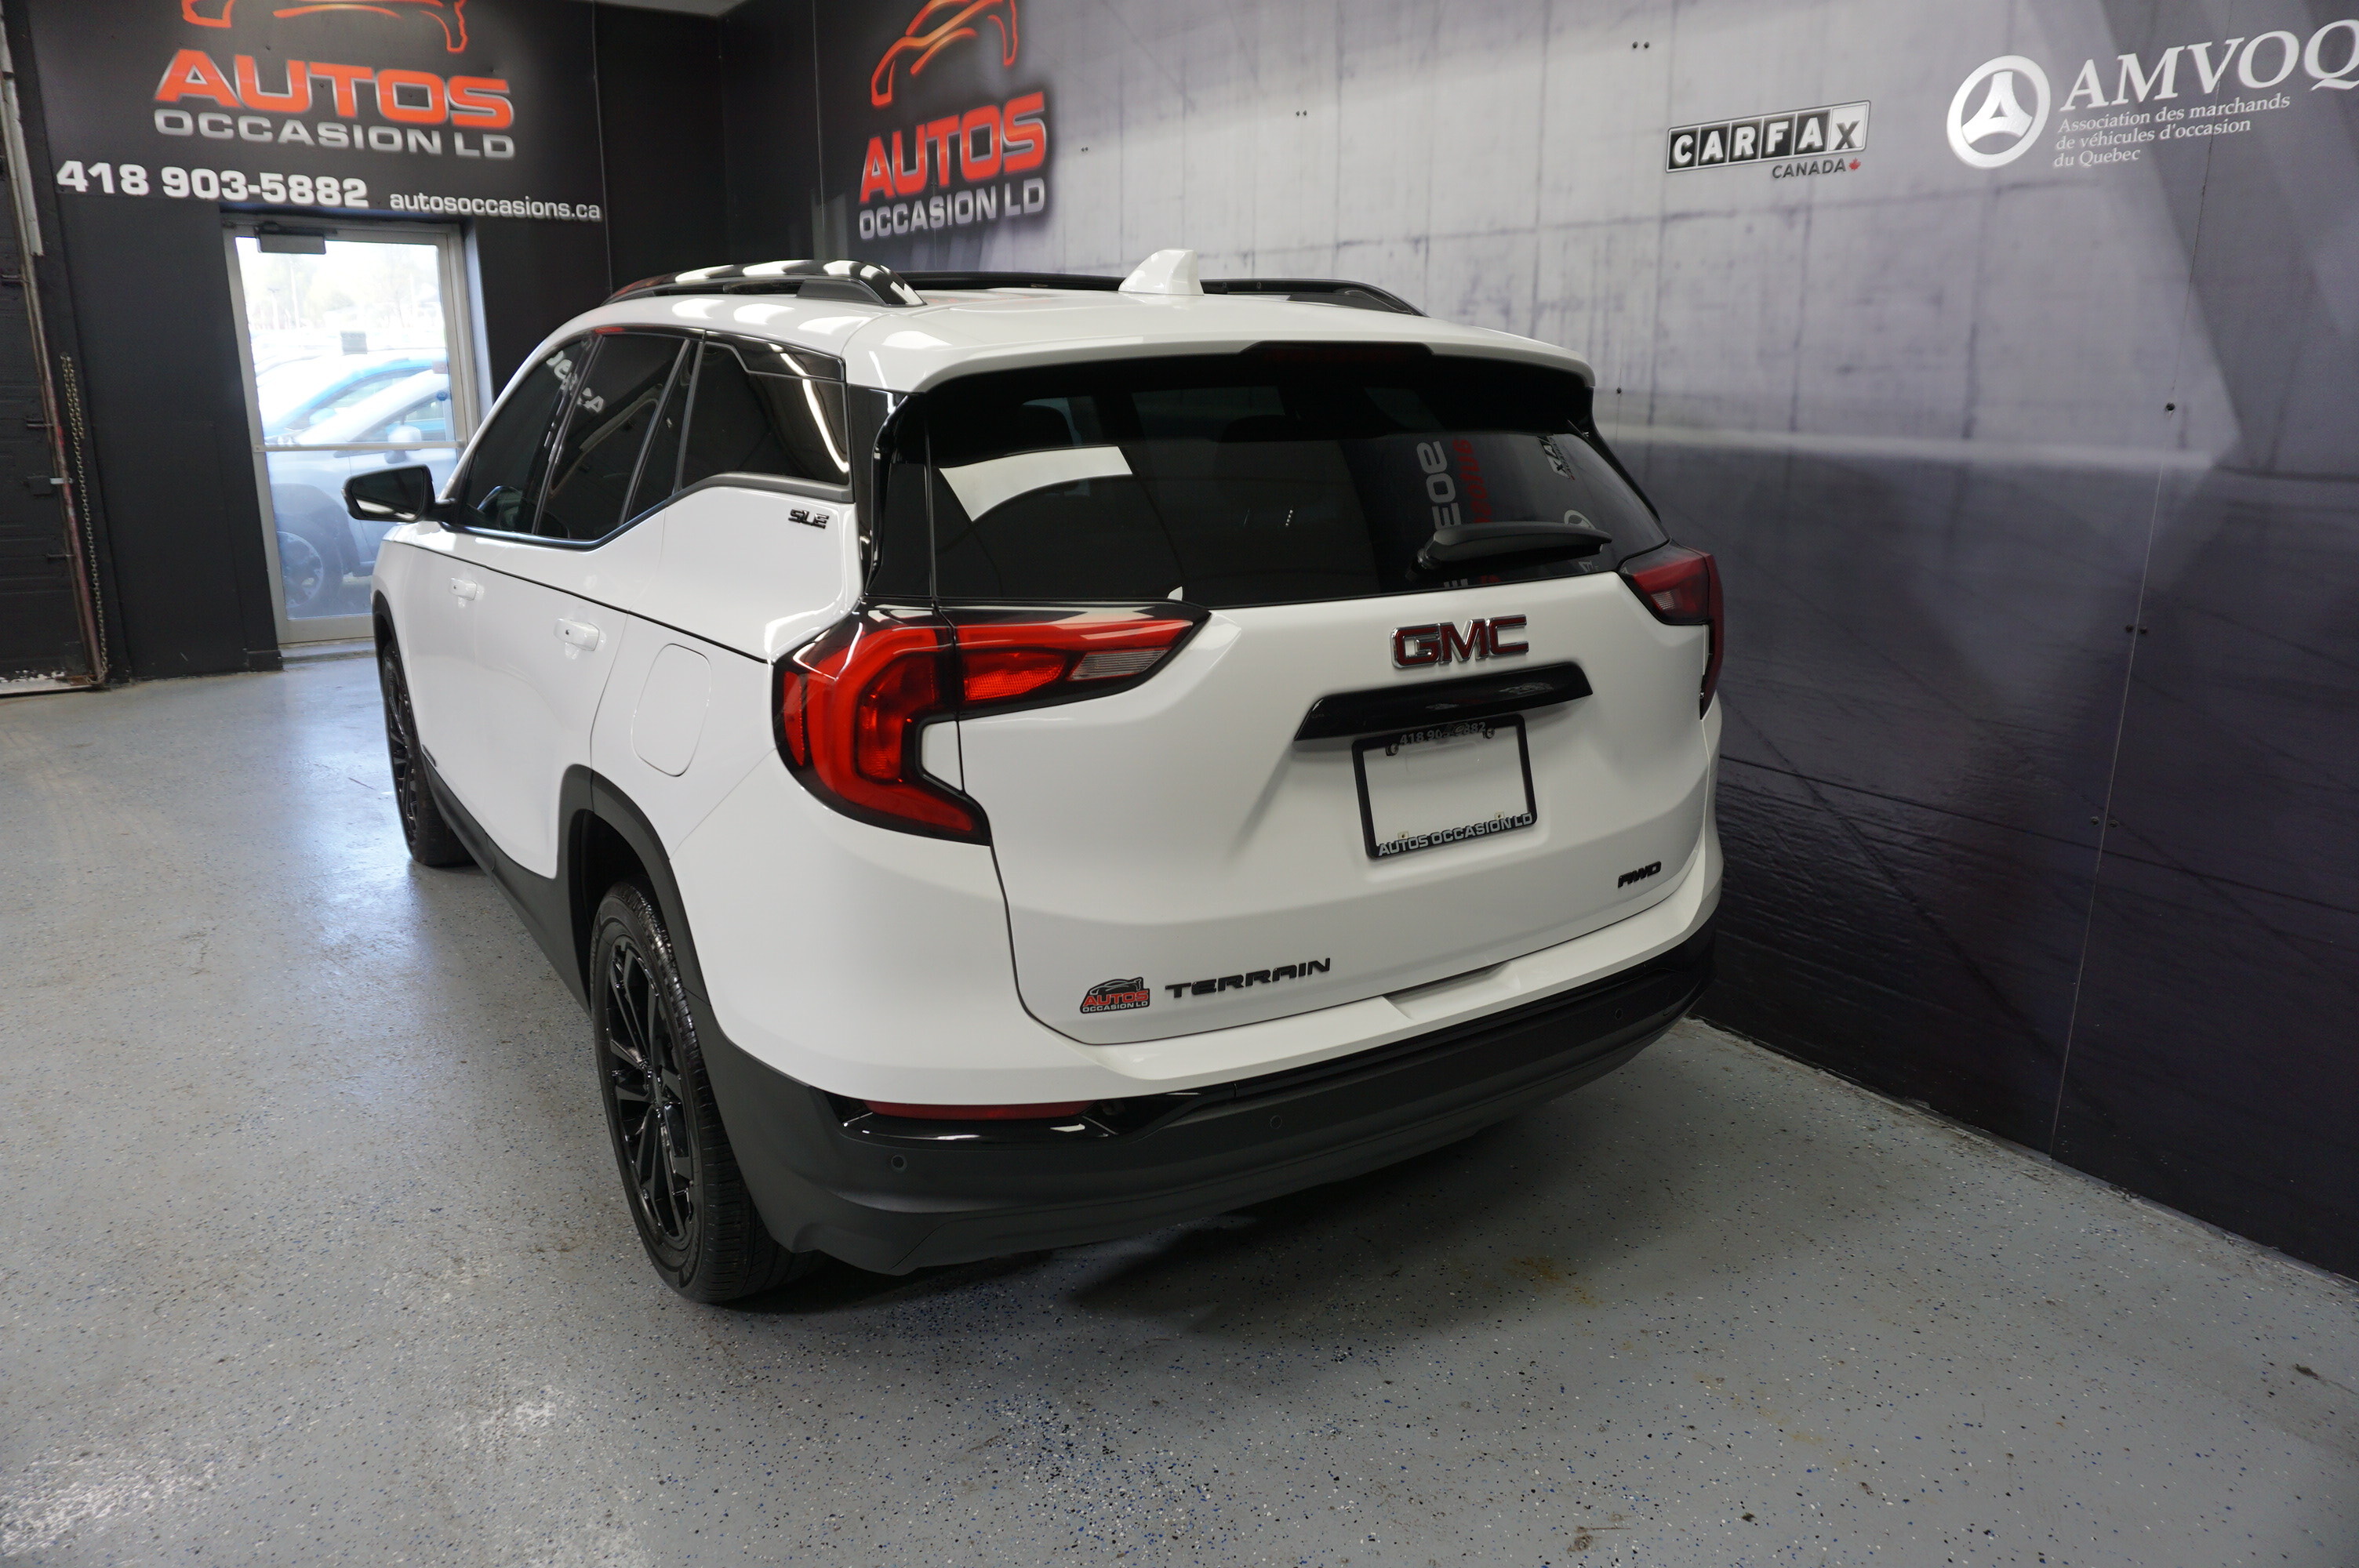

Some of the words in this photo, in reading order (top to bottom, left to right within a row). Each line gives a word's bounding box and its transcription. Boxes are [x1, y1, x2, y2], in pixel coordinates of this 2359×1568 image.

[2059, 20, 2359, 111] AMVOQ
[154, 49, 514, 129] AUTOS
[154, 108, 442, 155] OCCASION
[453, 132, 515, 159] LD
[2058, 111, 2150, 133] Association
[2155, 106, 2185, 122] des
[2189, 93, 2290, 118] marchands
[860, 91, 1046, 204] AUTOS
[1673, 117, 1861, 164] CARFAX
[2055, 136, 2076, 151] de
[2080, 126, 2155, 147] véhicules
[2159, 118, 2251, 140] d'occasion
[1772, 158, 1847, 179] CANADA
[2054, 152, 2075, 168] du
[2079, 147, 2141, 168] Quebec
[56, 161, 148, 196] 418
[162, 166, 369, 209] 903-5882
[390, 191, 602, 222] autosoccasions.ca
[860, 185, 997, 240] OCCASION
[1005, 177, 1045, 216] LD
[788, 508, 829, 529] SLE
[1390, 614, 1529, 669] GMC
[1379, 835, 1428, 856] AUTOS
[1431, 818, 1511, 844] OCCASION
[1514, 813, 1532, 827] LD
[1618, 861, 1662, 888] AWD
[1083, 989, 1148, 1007] AUTOS
[1165, 957, 1331, 998] TERRAIN
[1082, 1003, 1134, 1013] OCCASION
